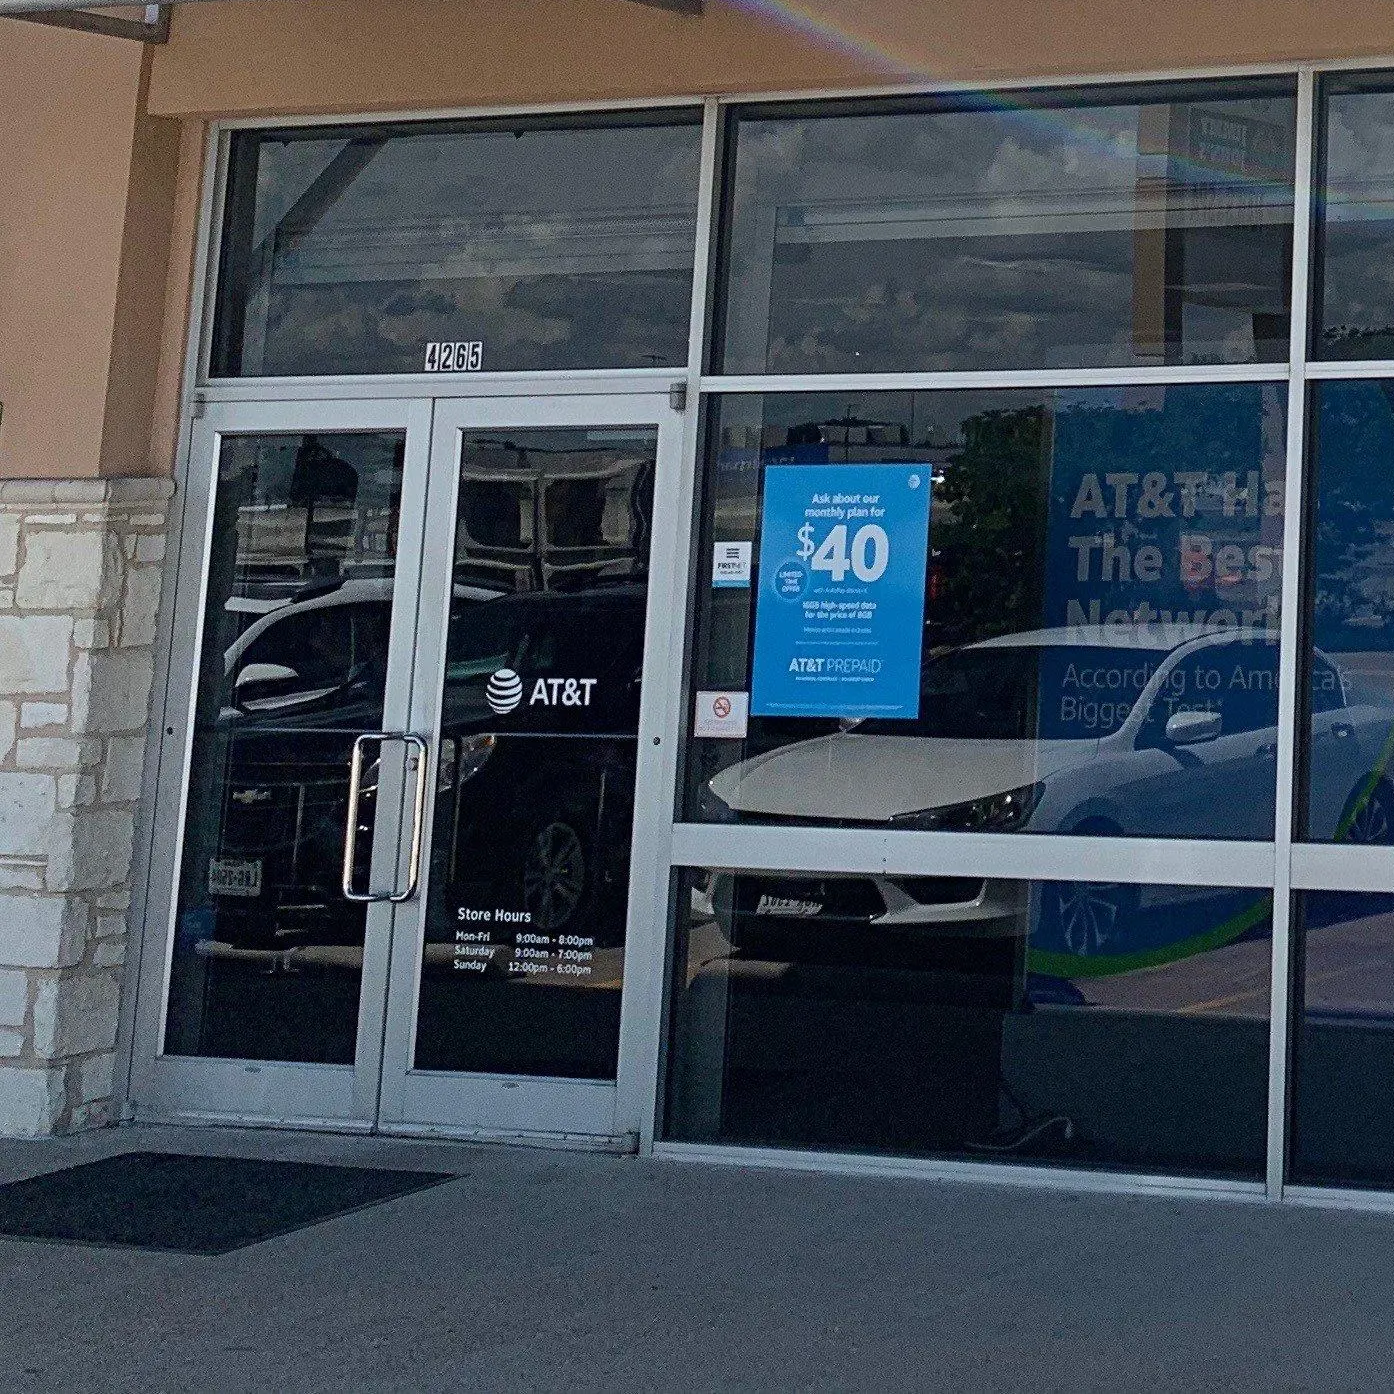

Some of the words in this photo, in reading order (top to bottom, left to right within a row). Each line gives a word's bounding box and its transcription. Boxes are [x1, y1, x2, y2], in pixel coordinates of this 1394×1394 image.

[427, 344, 480, 369] 4265
[812, 493, 830, 504] Ask
[832, 493, 861, 504] about
[862, 495, 880, 504] our
[1070, 472, 1206, 518] AT&T
[1221, 471, 1286, 517] Ha
[805, 506, 845, 519] monthly
[847, 506, 869, 519] plan
[870, 506, 886, 517] for
[796, 522, 889, 582] $40
[1068, 533, 1162, 582] The
[789, 658, 825, 672] AT&T
[826, 659, 882, 673] PREPAID
[1062, 663, 1186, 696] According
[1195, 668, 1221, 689] to
[529, 678, 598, 706] AT&T
[457, 907, 491, 921] Store
[495, 909, 532, 922] Hours
[455, 931, 490, 942] Mon-Fri
[516, 933, 550, 944] 9:00am
[558, 935, 594, 947] 8:00pm
[454, 945, 495, 959] Saturday
[515, 948, 549, 958] 9:00am
[558, 949, 593, 961] 7:00pm
[454, 959, 487, 973] Sunday
[508, 962, 548, 973] 12:00pm
[556, 963, 592, 976] 6:00pm
